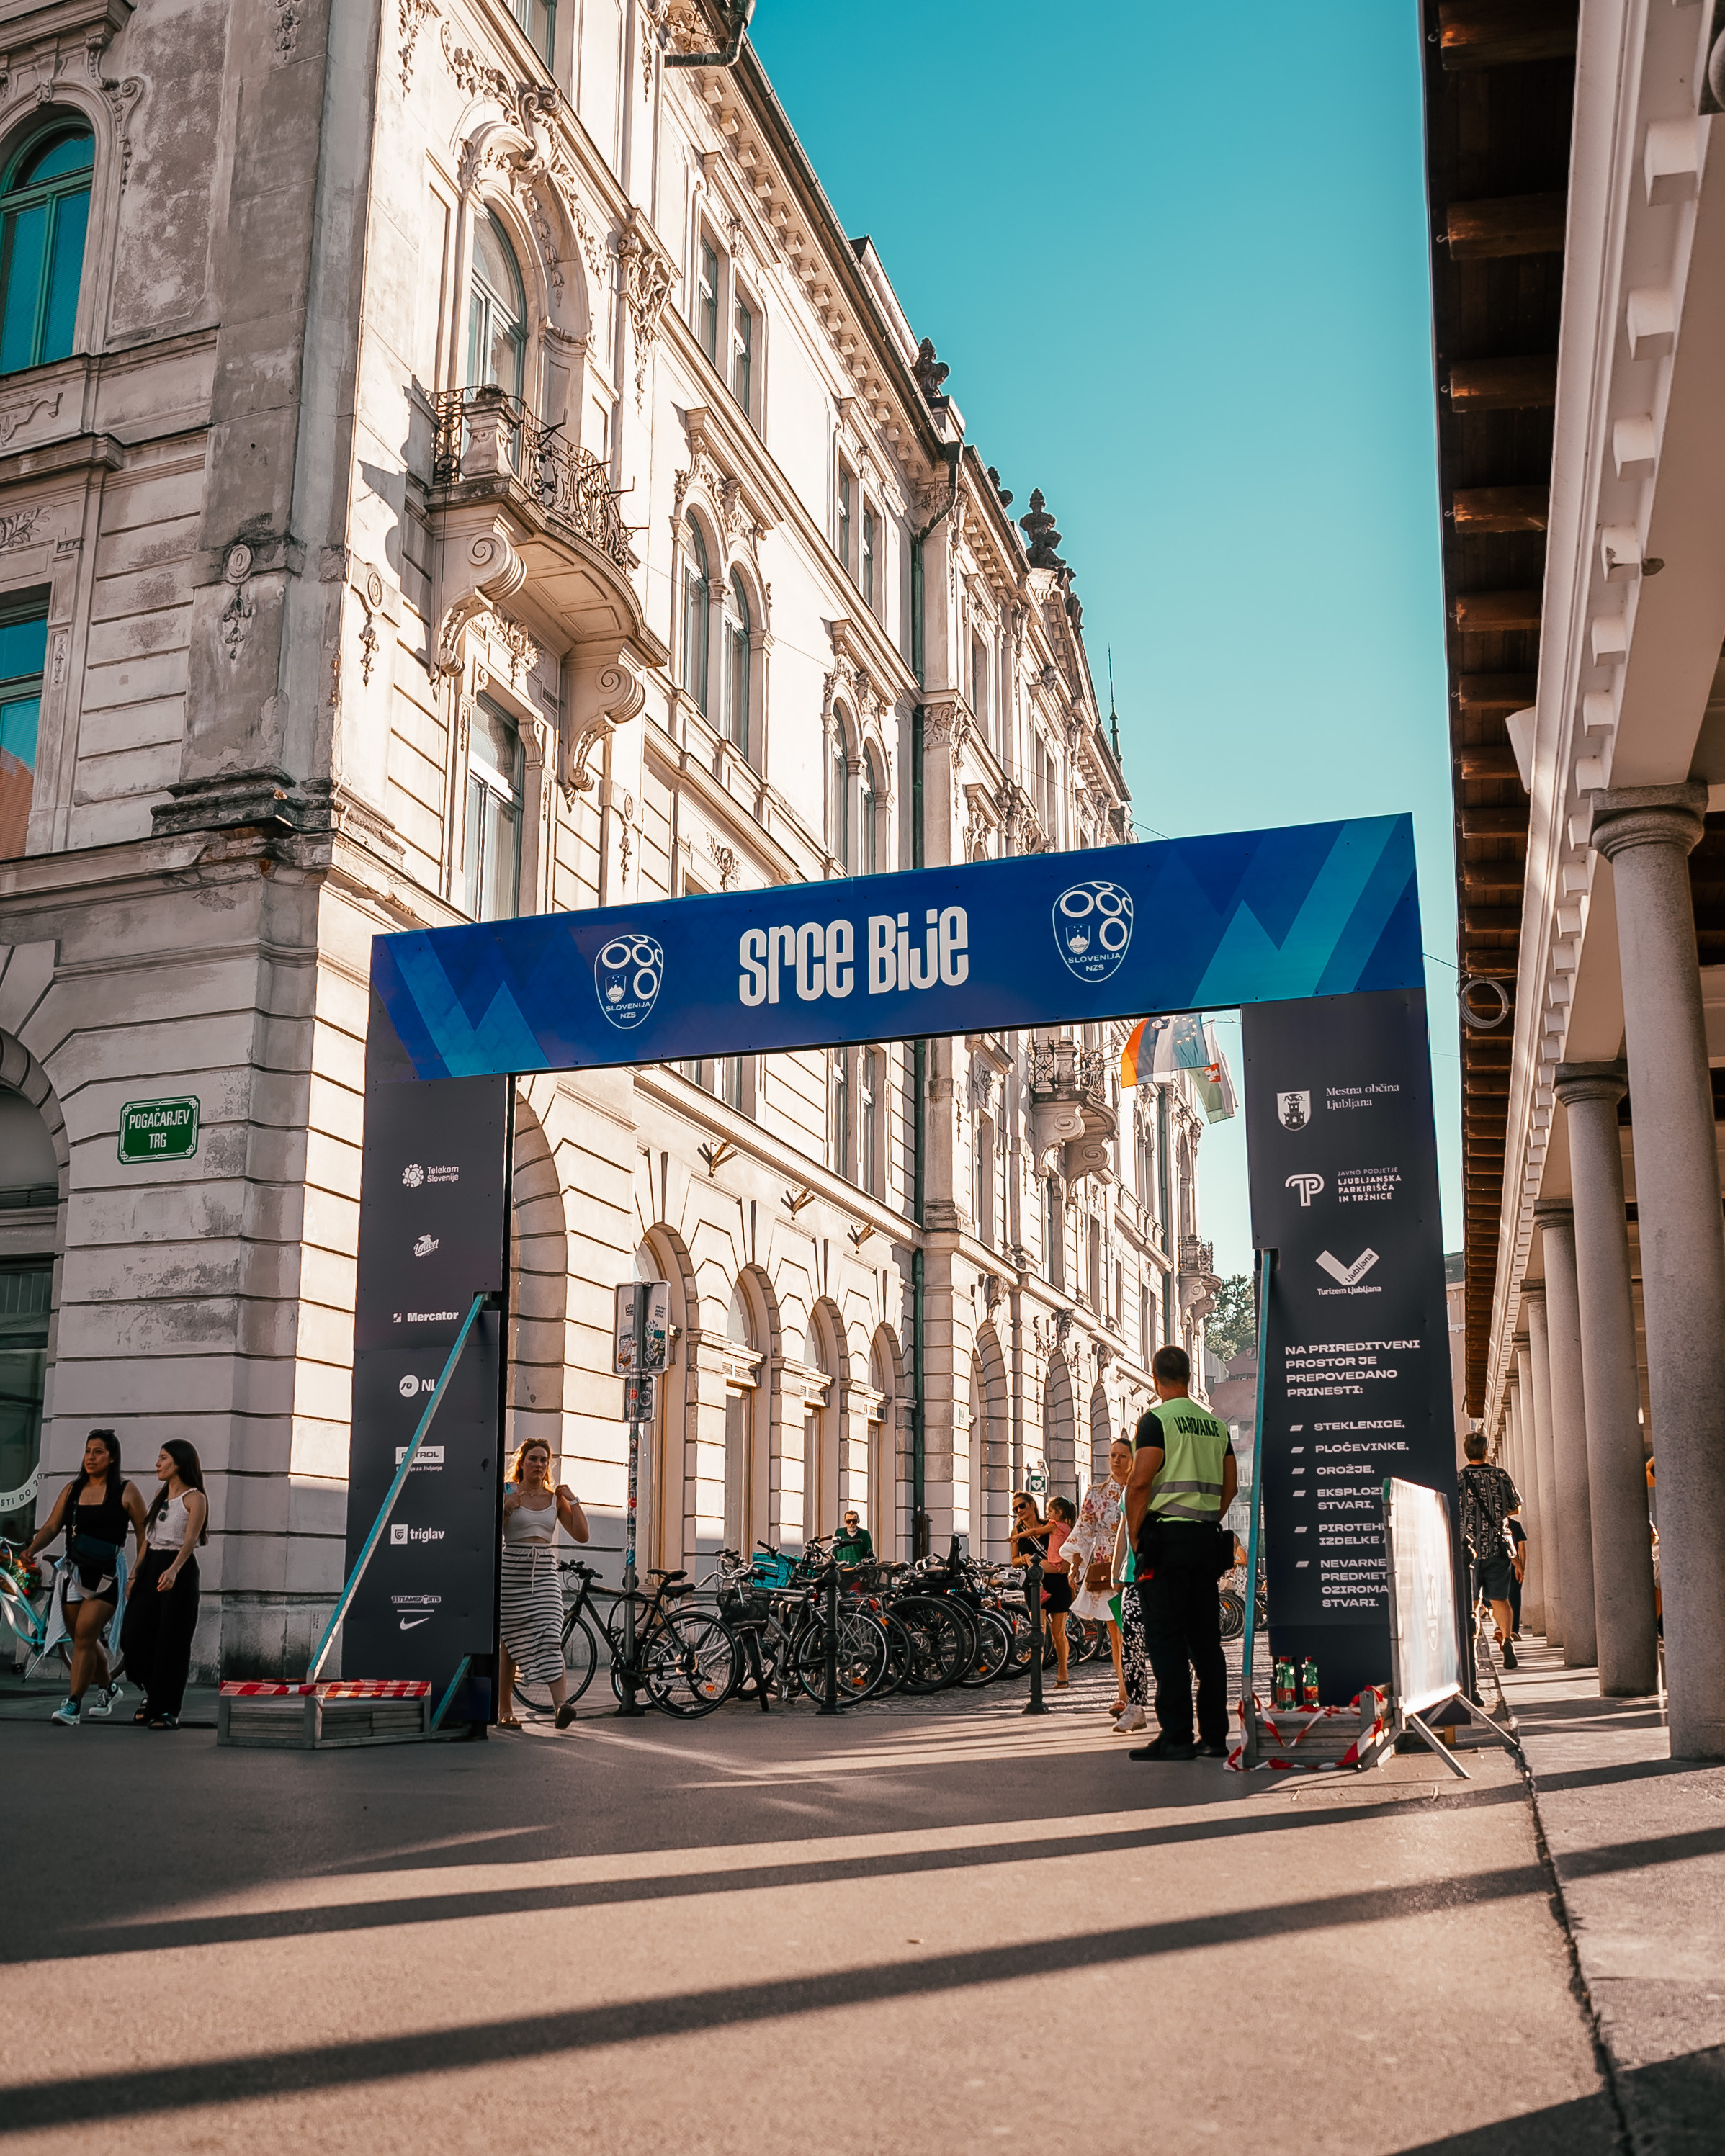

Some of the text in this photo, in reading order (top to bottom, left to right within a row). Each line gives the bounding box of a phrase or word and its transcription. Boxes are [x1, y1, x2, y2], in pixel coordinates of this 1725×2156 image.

[1068, 953, 1121, 964] SLOVENIJA
[606, 1001, 650, 1012] SLOVENIJA
[1326, 1083, 1399, 1096] Mestna občina
[1327, 1098, 1372, 1110] Ljubljana
[129, 1108, 190, 1130] POGAČARJEV
[148, 1133, 167, 1149] TRG
[427, 1165, 459, 1174] Telekom
[427, 1173, 459, 1183] Slovenije
[1338, 1174, 1402, 1185] LJUBLJANSKA
[1338, 1182, 1394, 1194] PARKIRIŠČA
[1352, 1192, 1392, 1202] TRŽNICE
[1345, 1253, 1374, 1283] Ljubljana
[1347, 1285, 1382, 1295] Ljubljana
[407, 1311, 459, 1322] Mercator
[1285, 1339, 1420, 1355] NA PRIREDITVENI
[1286, 1356, 1377, 1369] PROSTOR JE
[1286, 1370, 1398, 1383] PREPOVEDANO
[421, 1378, 436, 1392] NL
[1286, 1385, 1363, 1397] PRINESTI:
[1314, 1419, 1405, 1431] STEKLENICE,
[1315, 1442, 1410, 1453] PLOČEVINKE,
[1316, 1463, 1375, 1475] OROŽJE,
[19, 1488, 31, 1501] DO
[1317, 1501, 1374, 1510] STVARI,
[410, 1527, 445, 1543] triglav
[1319, 1536, 1379, 1545] IZDELKE
[1322, 1585, 1389, 1594] OZIROMA
[1322, 1598, 1379, 1607] STVARI.
